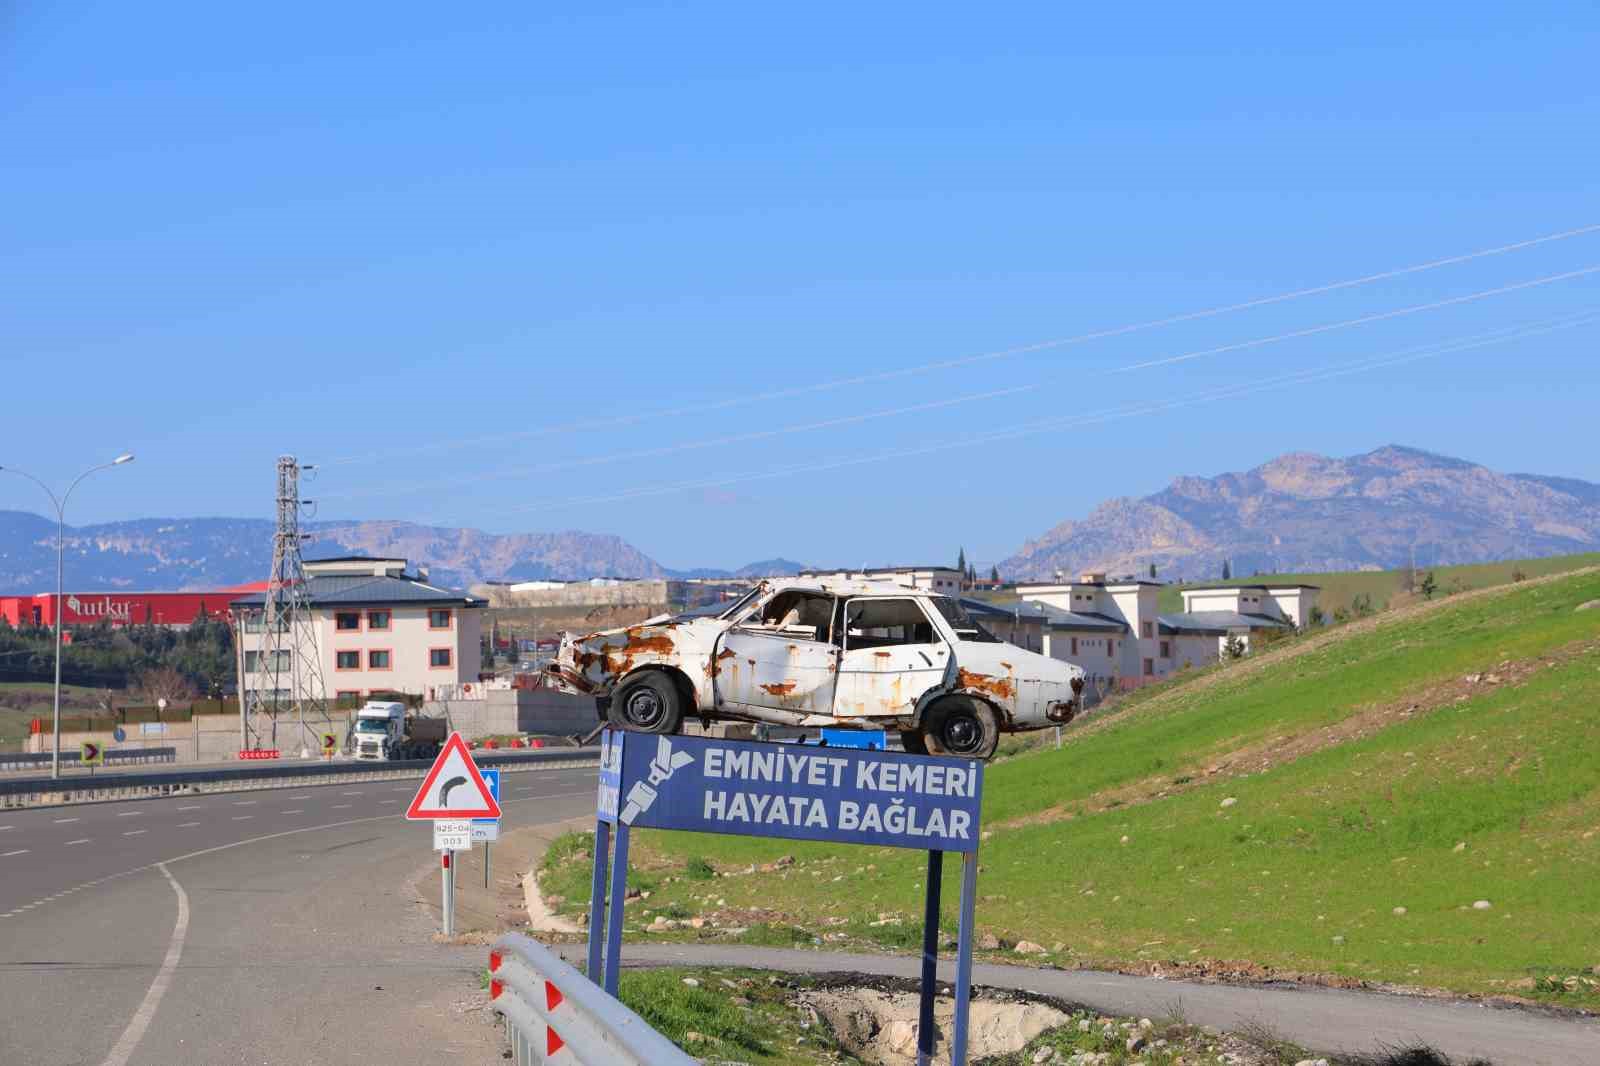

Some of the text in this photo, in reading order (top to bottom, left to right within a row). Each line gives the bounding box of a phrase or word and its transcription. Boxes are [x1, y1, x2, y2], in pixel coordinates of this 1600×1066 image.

[703, 748, 978, 798] EMNİYET KEMERİ
[703, 791, 971, 840] HAYATA BAĞLAR
